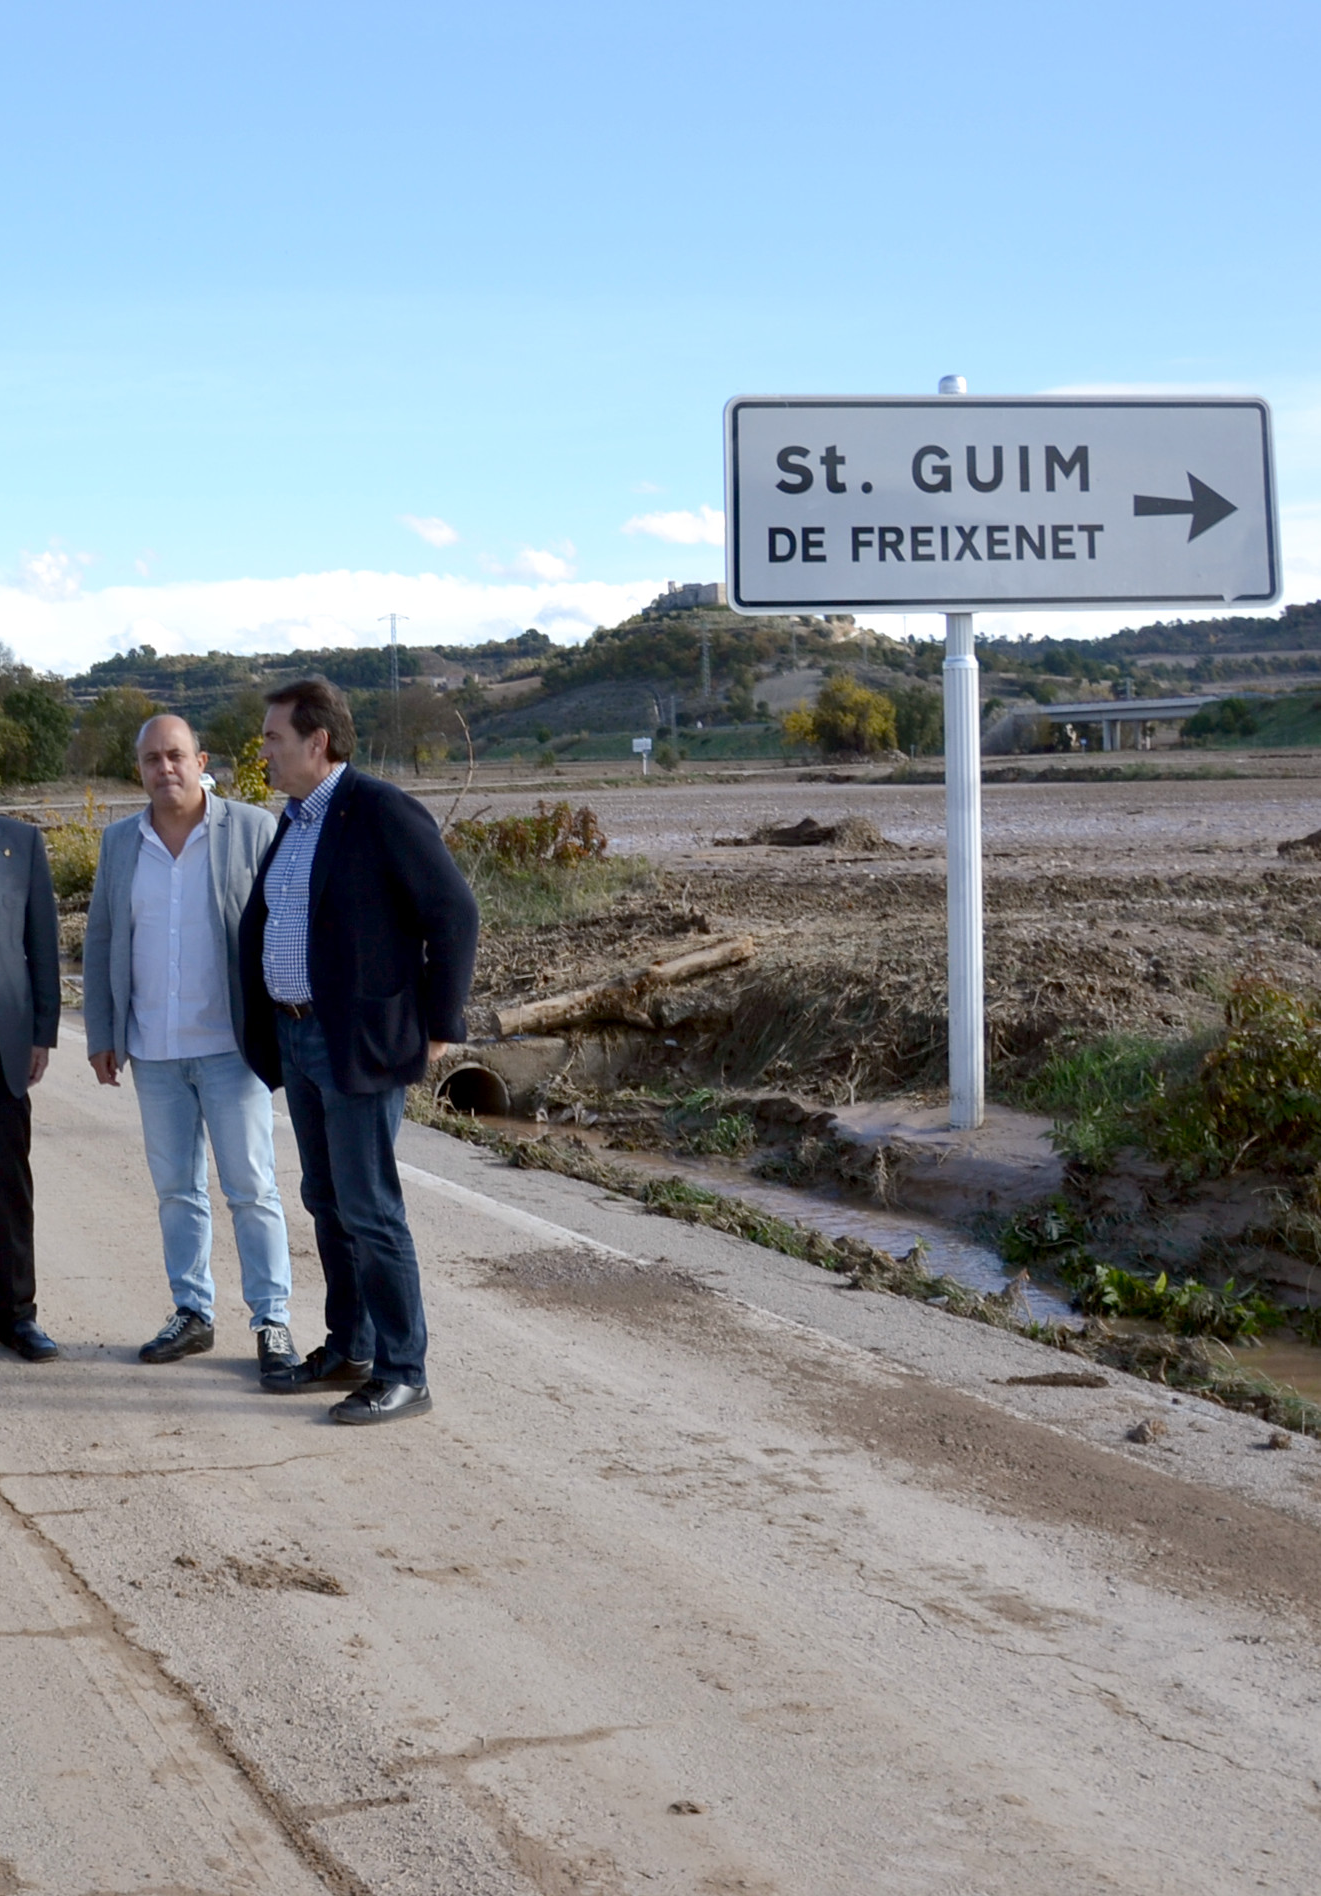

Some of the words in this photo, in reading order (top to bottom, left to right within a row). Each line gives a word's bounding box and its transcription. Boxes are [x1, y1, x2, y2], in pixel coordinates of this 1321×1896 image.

[775, 445, 873, 494] St.
[911, 445, 1090, 494] GUIM
[767, 526, 827, 563] DE
[851, 523, 1104, 563] FREIXENET
